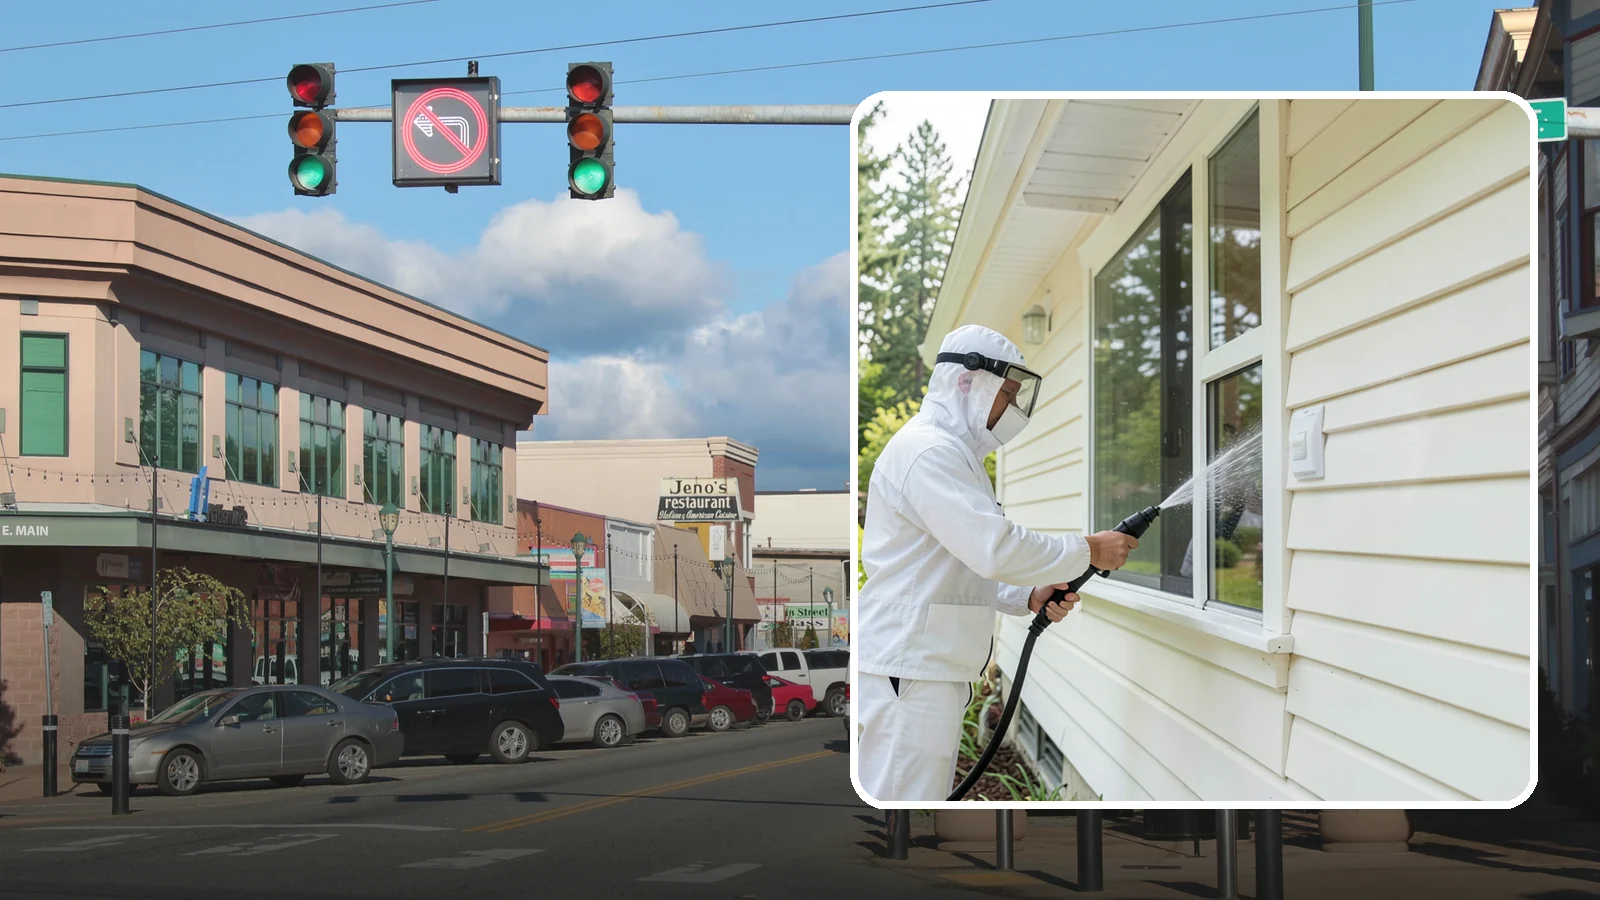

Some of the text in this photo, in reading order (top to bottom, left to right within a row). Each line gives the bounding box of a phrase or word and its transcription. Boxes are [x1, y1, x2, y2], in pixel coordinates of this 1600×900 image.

[670, 480, 727, 494] Jeno's
[665, 496, 731, 509] restaurant
[658, 509, 681, 519] Italian
[686, 509, 714, 519] American
[714, 509, 737, 519] Cuisine
[2, 525, 49, 536] E. MAIN
[797, 607, 828, 617] Street
